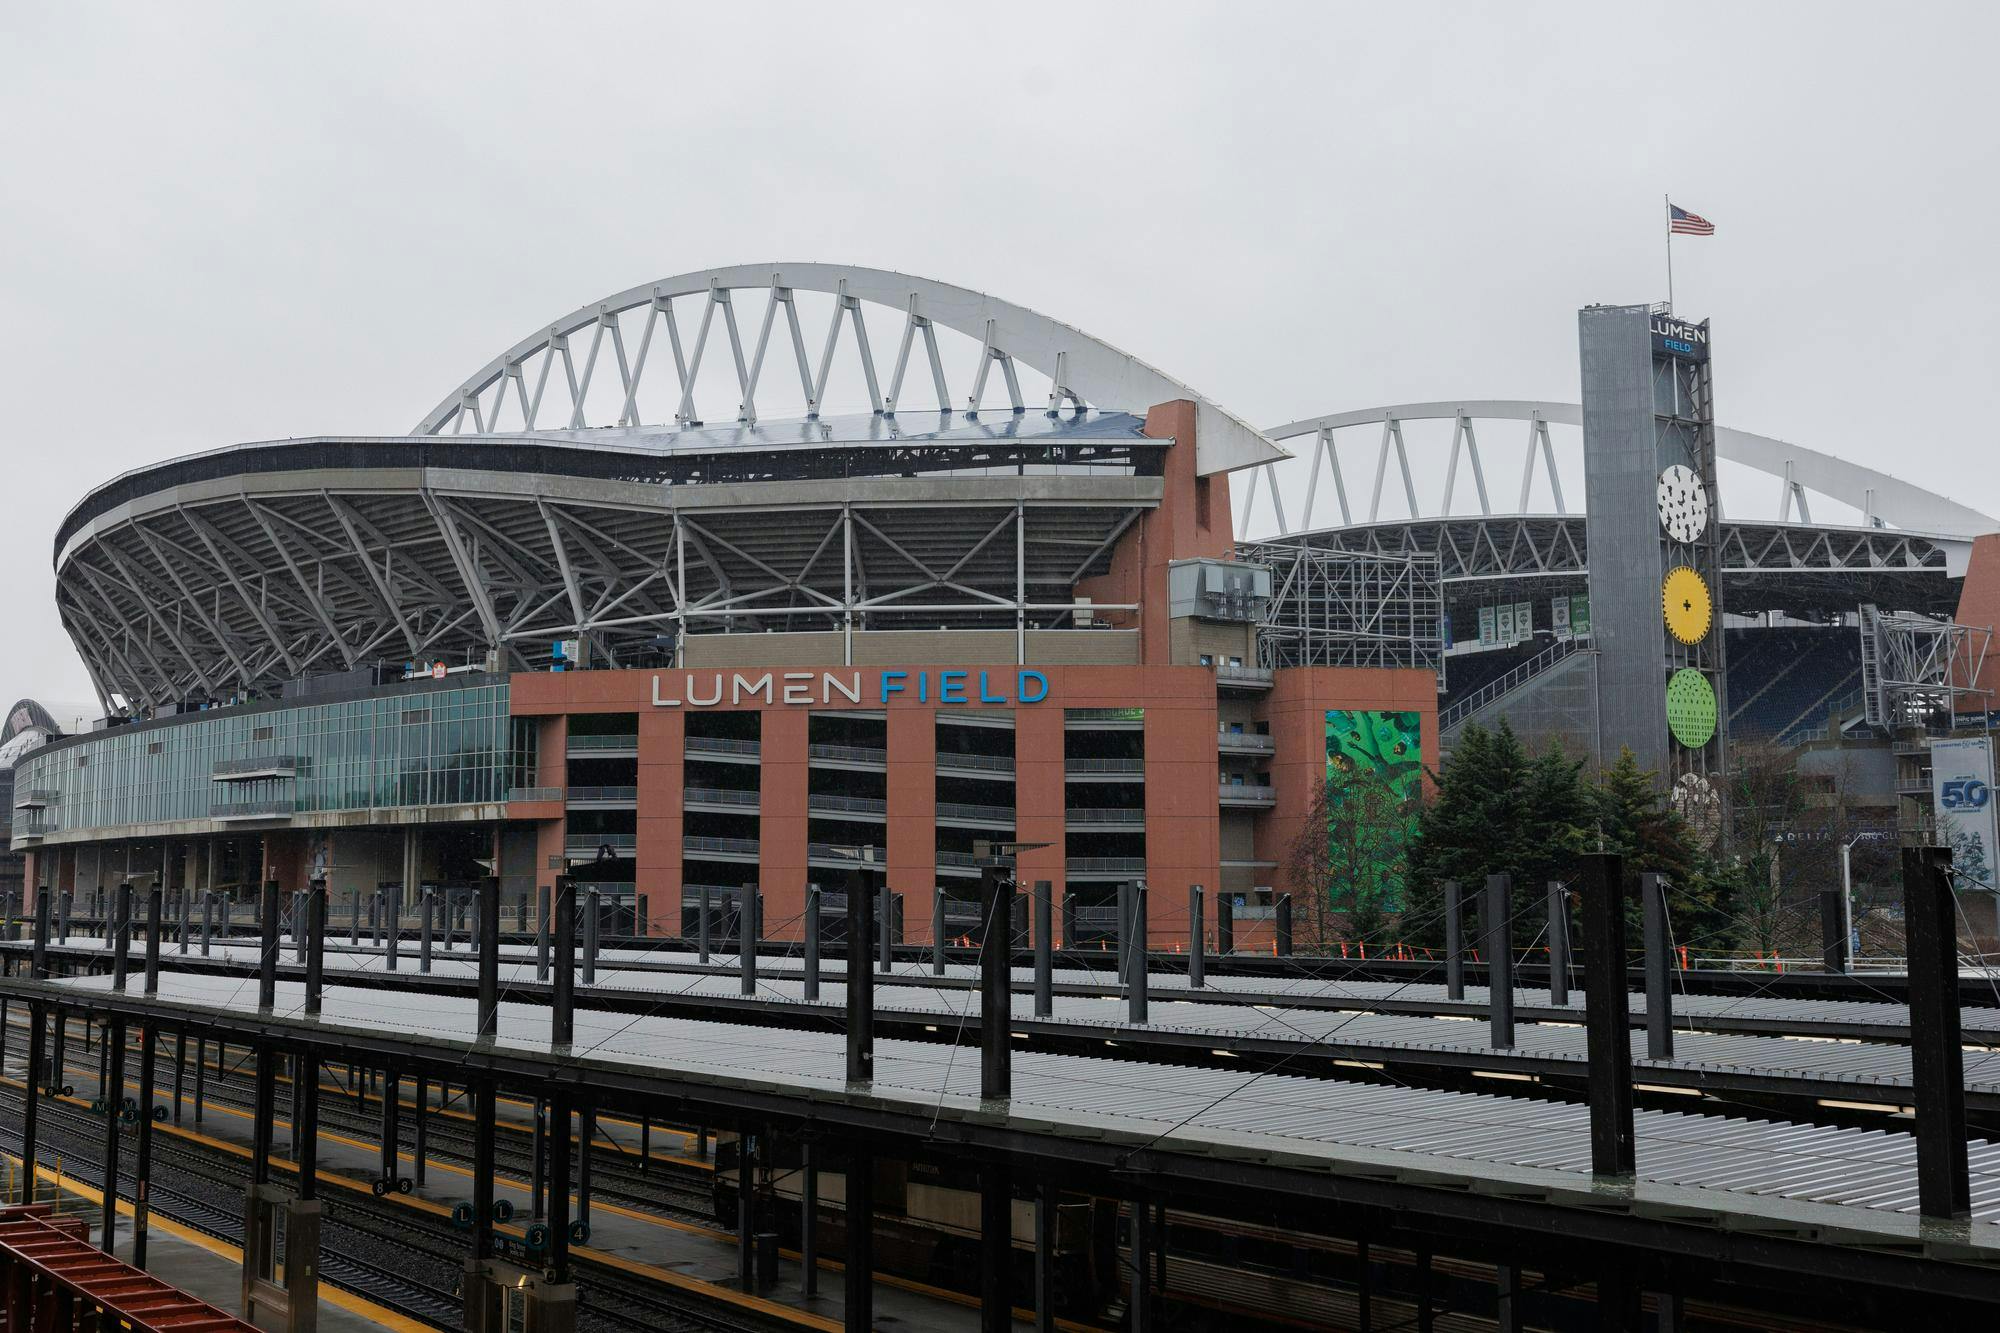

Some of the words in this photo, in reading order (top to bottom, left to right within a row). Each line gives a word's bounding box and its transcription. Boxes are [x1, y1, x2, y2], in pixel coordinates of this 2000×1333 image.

[1664, 339, 1691, 353] FIELD
[652, 672, 861, 706] LUMEN
[880, 671, 1049, 704] FIELD
[1941, 780, 1988, 809] 50
[1787, 832, 1831, 841] DELTA
[96, 1102, 105, 1111] M
[124, 1101, 133, 1110] M
[128, 1111, 134, 1120] 3
[156, 1109, 163, 1117] 4
[377, 1182, 384, 1193] 8
[401, 1181, 408, 1192] 8
[460, 1208, 468, 1222] L
[499, 1206, 507, 1218] L
[533, 1230, 543, 1245] 3
[573, 1226, 583, 1240] 4
